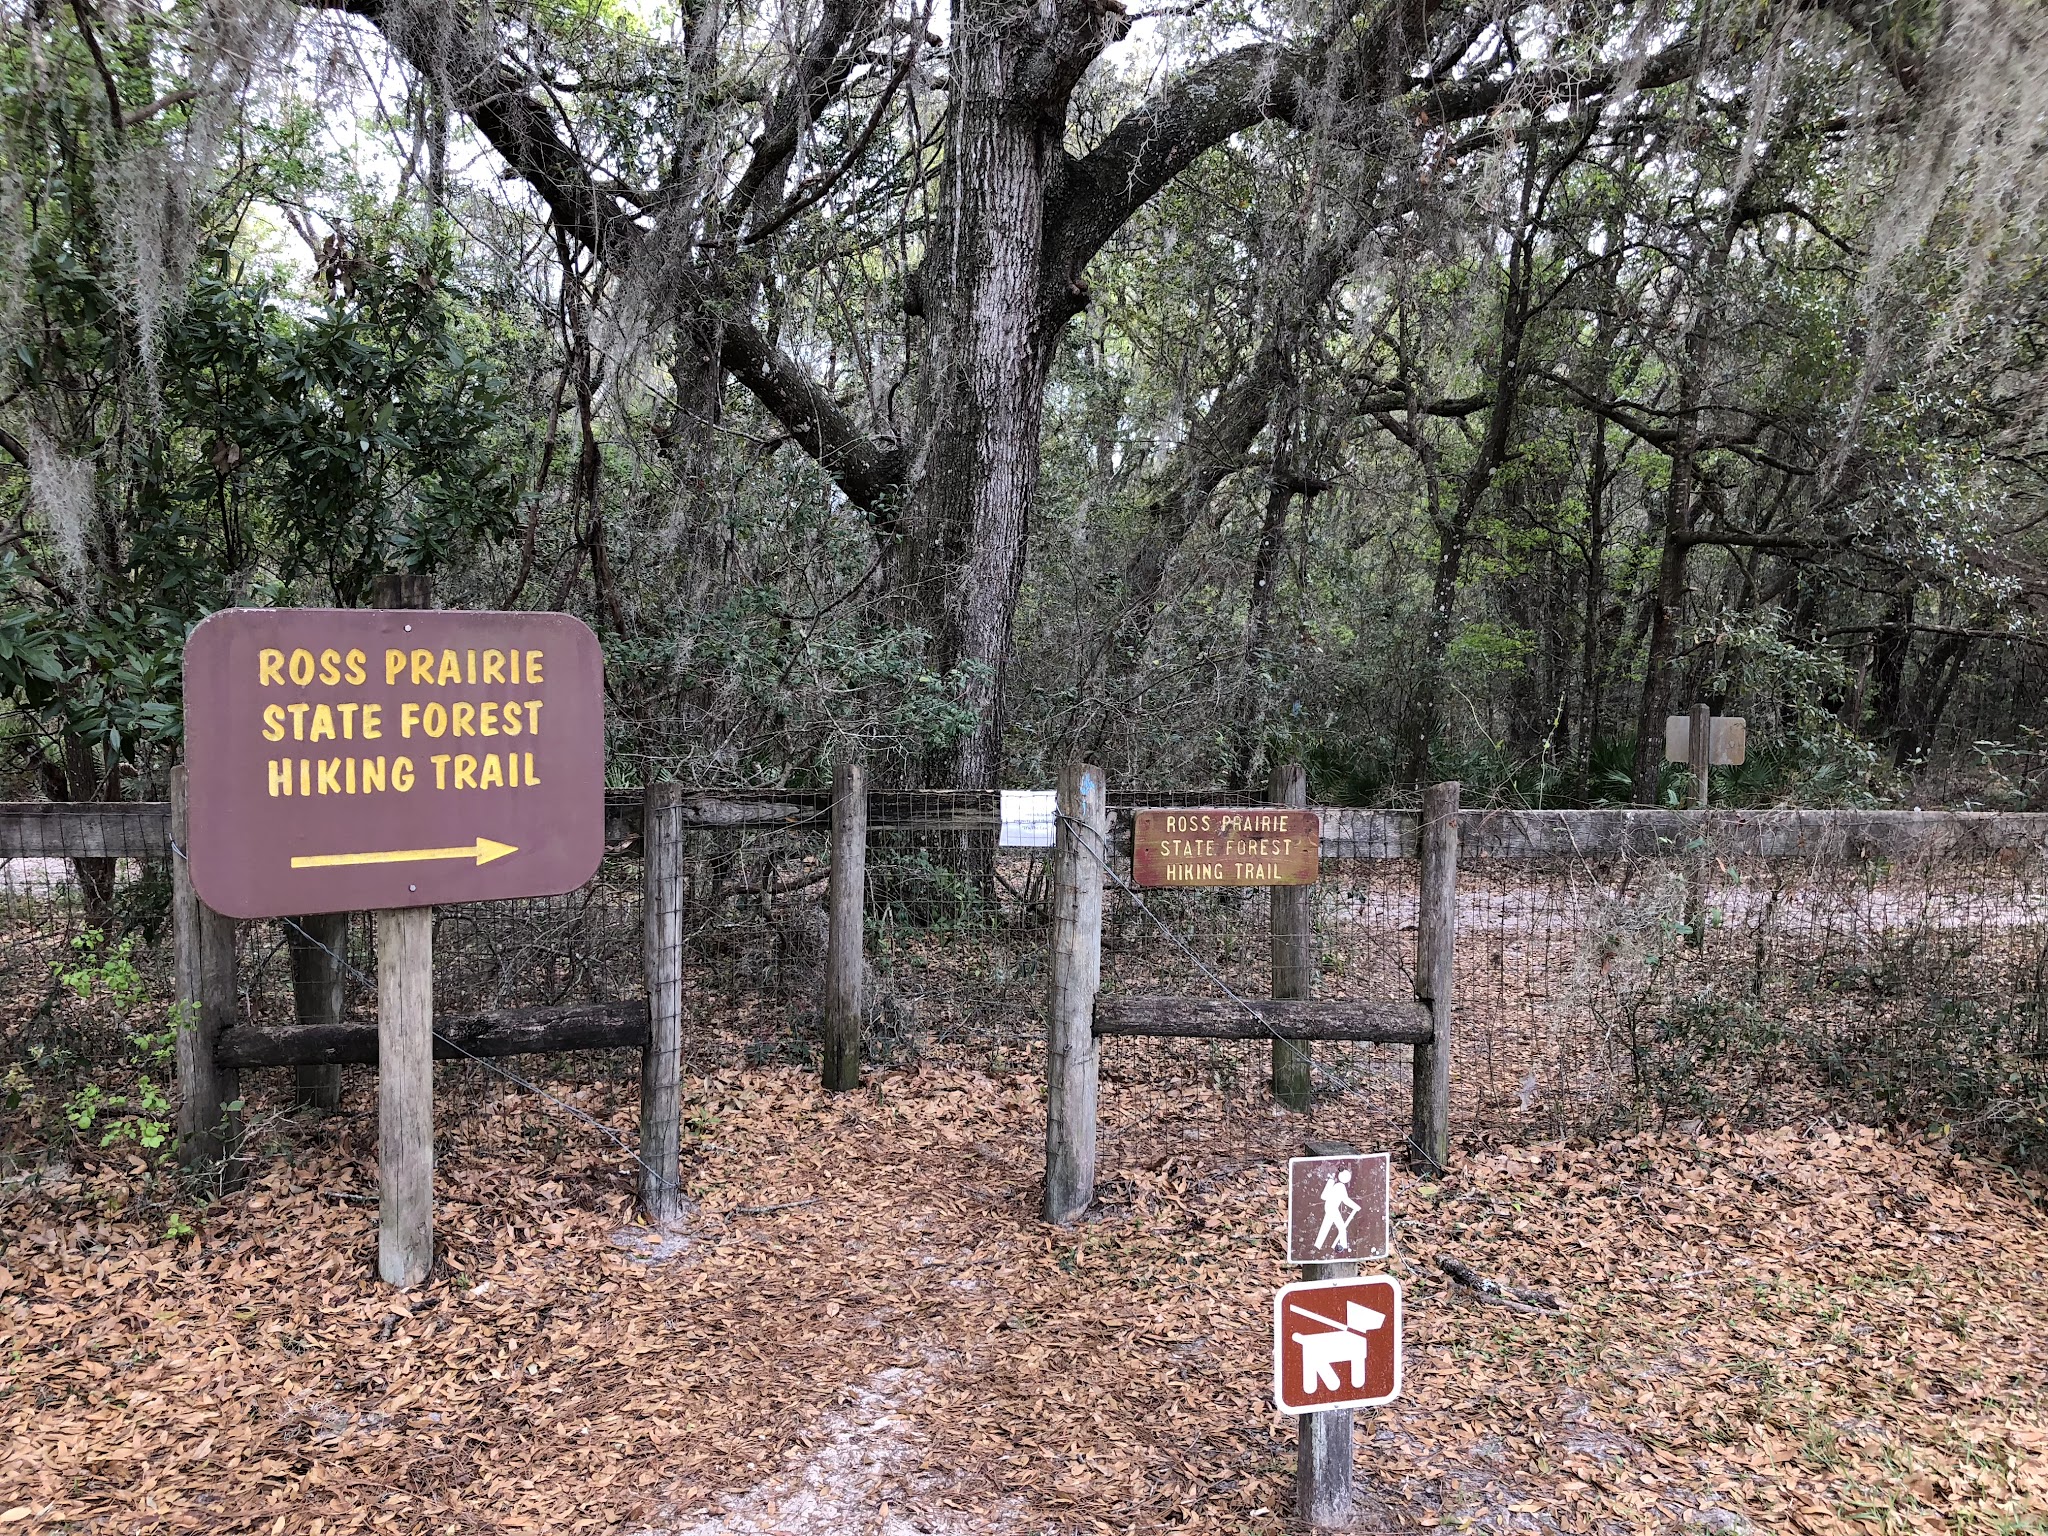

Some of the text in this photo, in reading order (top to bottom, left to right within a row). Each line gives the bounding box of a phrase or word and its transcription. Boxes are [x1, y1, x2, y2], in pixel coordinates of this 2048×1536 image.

[259, 648, 544, 686] ROSS PRAIRIE
[261, 700, 544, 742] STATE FOREST
[267, 752, 541, 797] HIKING TRAIL
[1166, 815, 1289, 832] ROSS PRAIRIE
[1160, 839, 1291, 856] STATE FOREST
[1166, 863, 1282, 881] HIKING TRAIL
